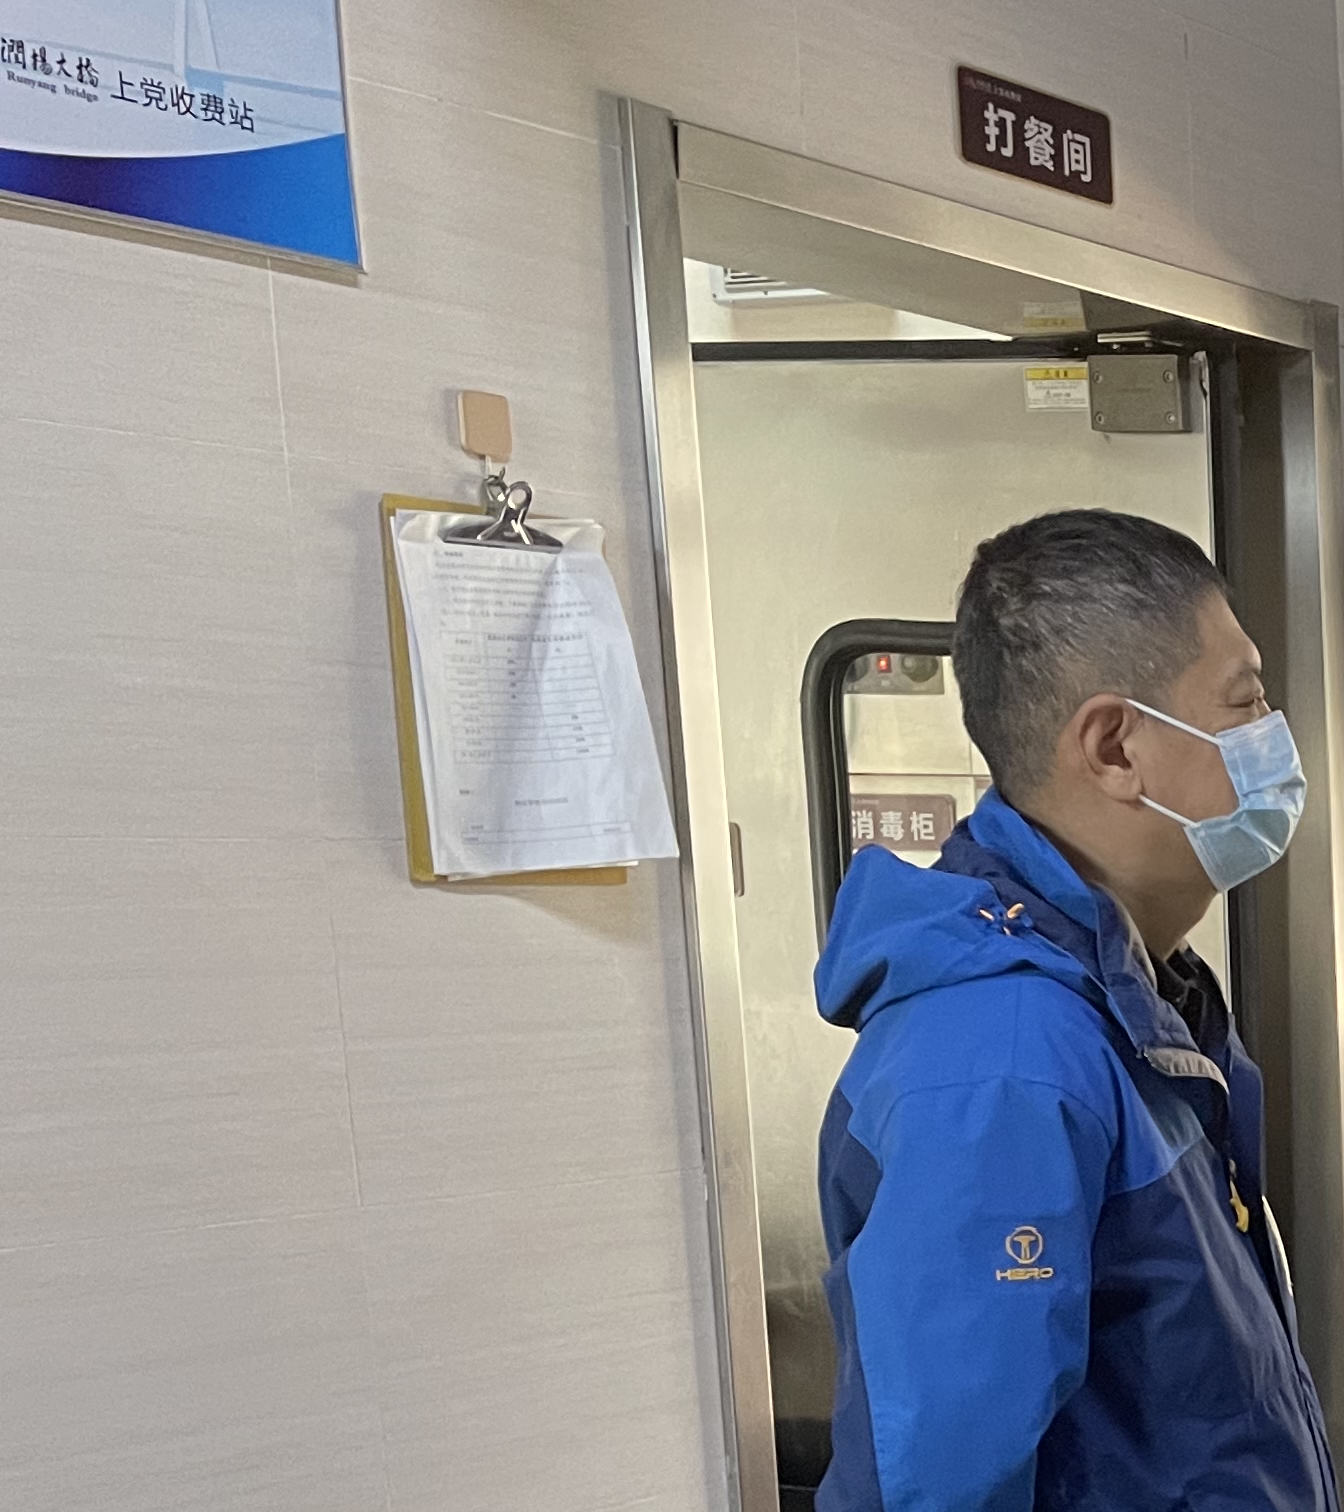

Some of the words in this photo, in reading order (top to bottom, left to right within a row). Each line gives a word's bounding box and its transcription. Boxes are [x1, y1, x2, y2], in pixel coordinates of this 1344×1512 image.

[6, 69, 57, 94] Runyang
[64, 83, 99, 103] bridge
[110, 70, 255, 133] 上党收费站
[983, 101, 1093, 183] 打餐间
[852, 811, 935, 841] 消毒柜
